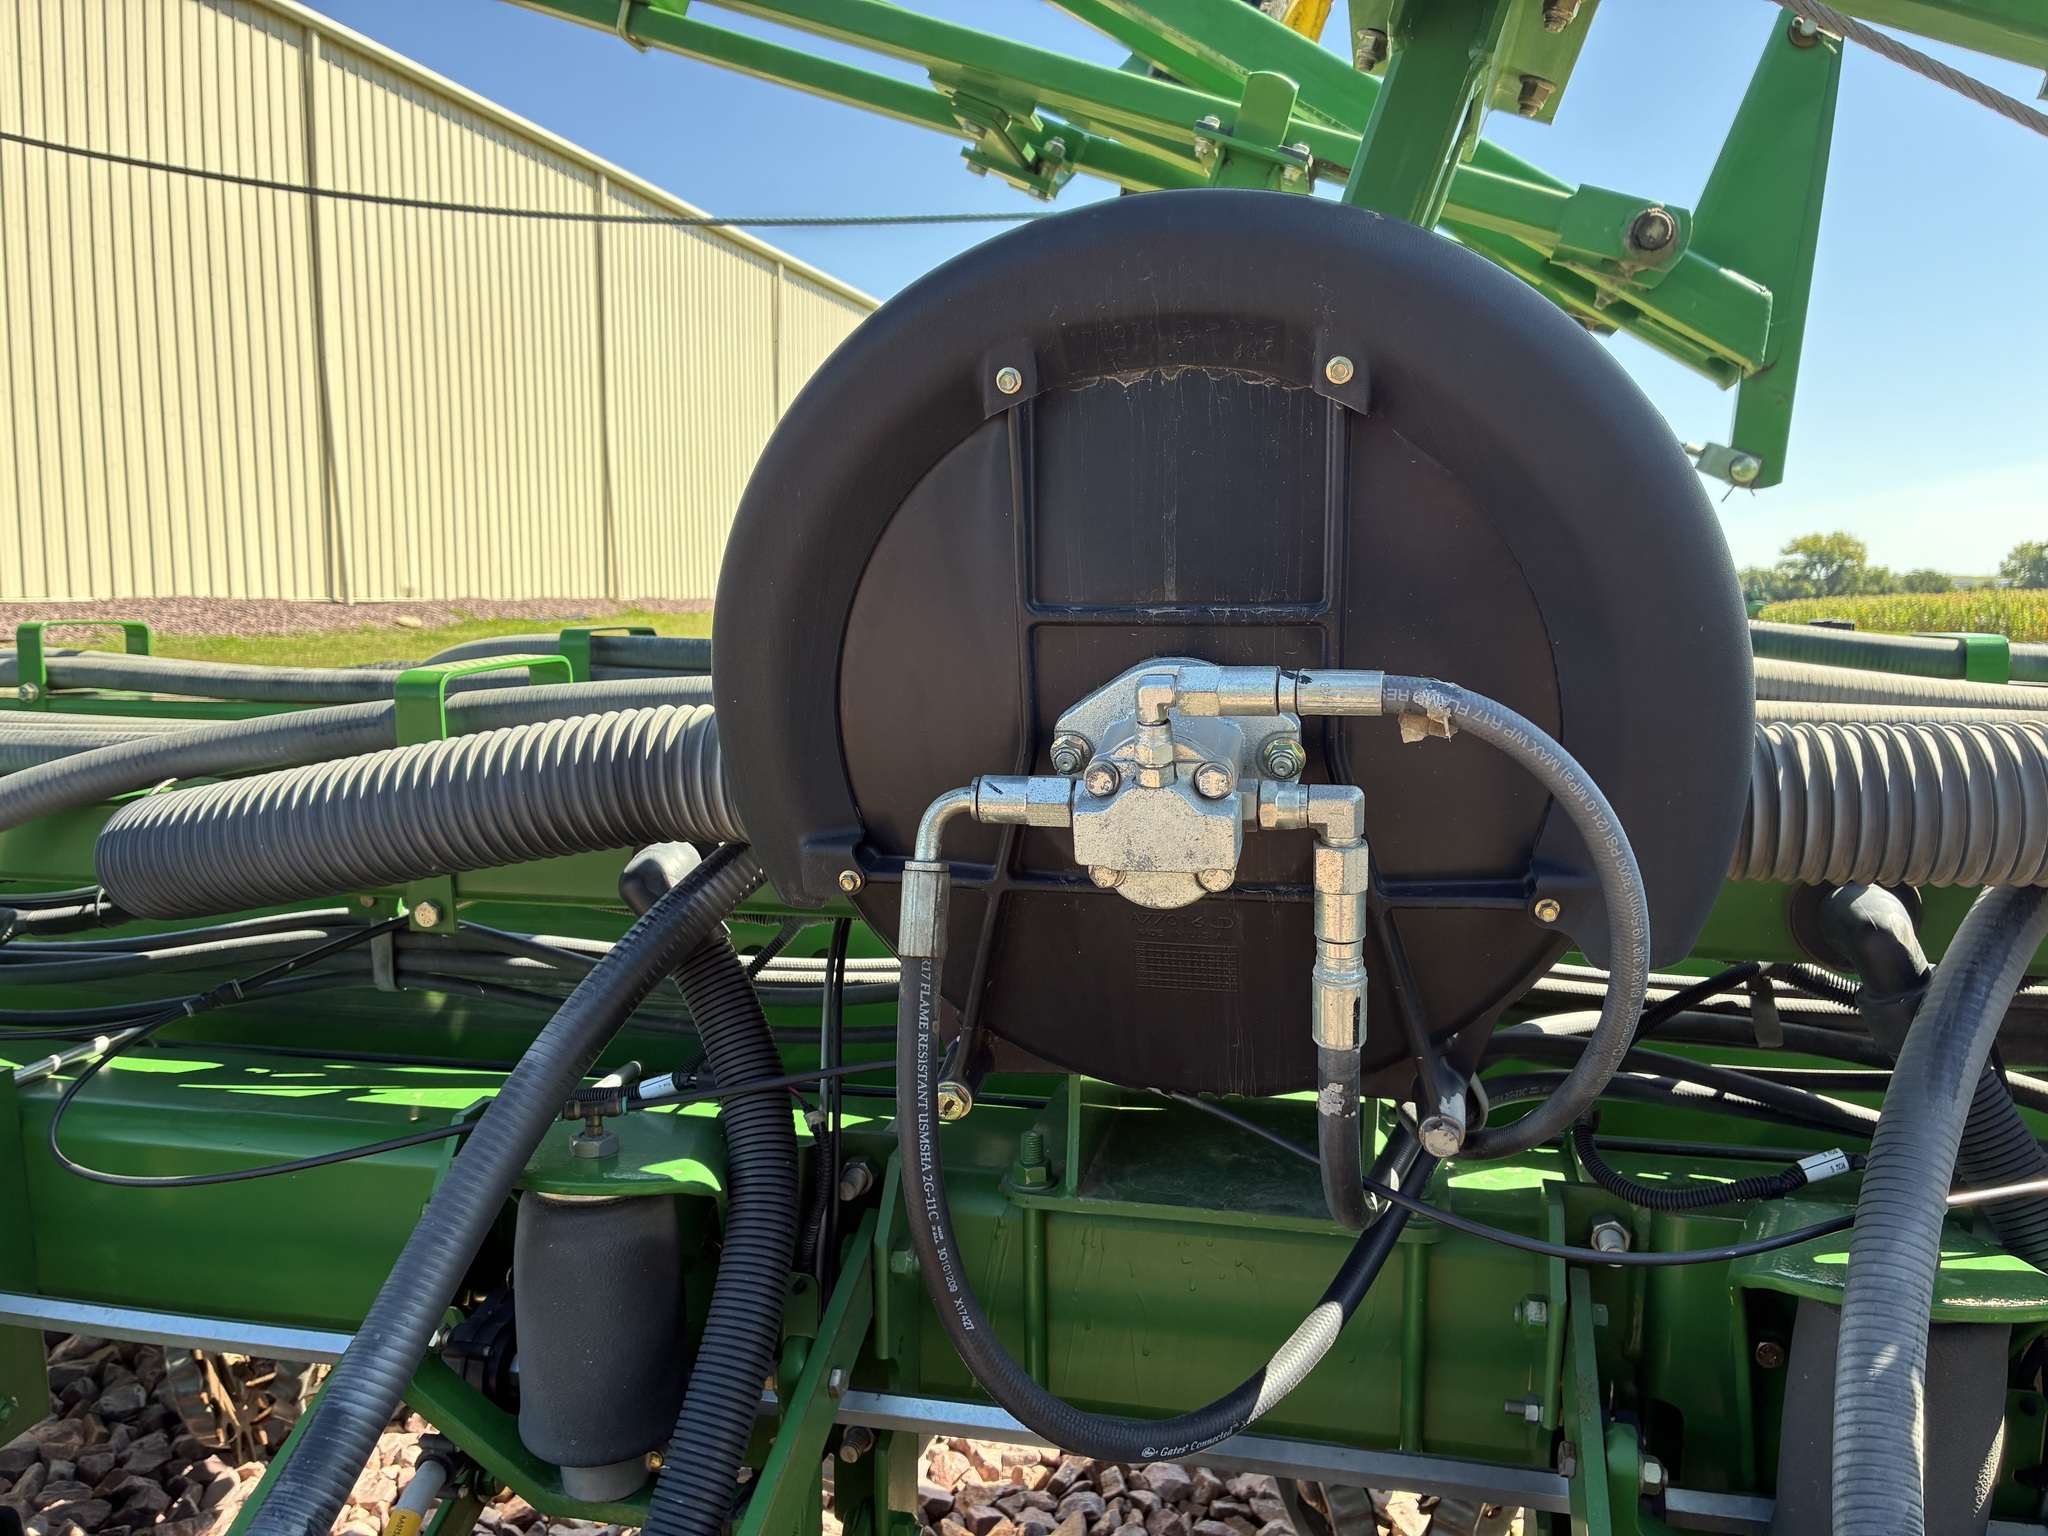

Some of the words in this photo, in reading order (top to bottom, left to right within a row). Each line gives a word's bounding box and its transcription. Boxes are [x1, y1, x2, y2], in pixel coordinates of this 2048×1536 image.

[1471, 708, 1503, 731] R17
[1503, 727, 1529, 747] WP
[1527, 740, 1561, 772] MAX
[1559, 766, 1590, 802] MPa)
[1604, 832, 1623, 858] PSI
[1615, 857, 1633, 890] 3000
[918, 981, 932, 1031] FLAME
[917, 1032, 930, 1111] RESISTANT
[922, 1173, 940, 1221] 2G-11C
[953, 1296, 975, 1332] X17427
